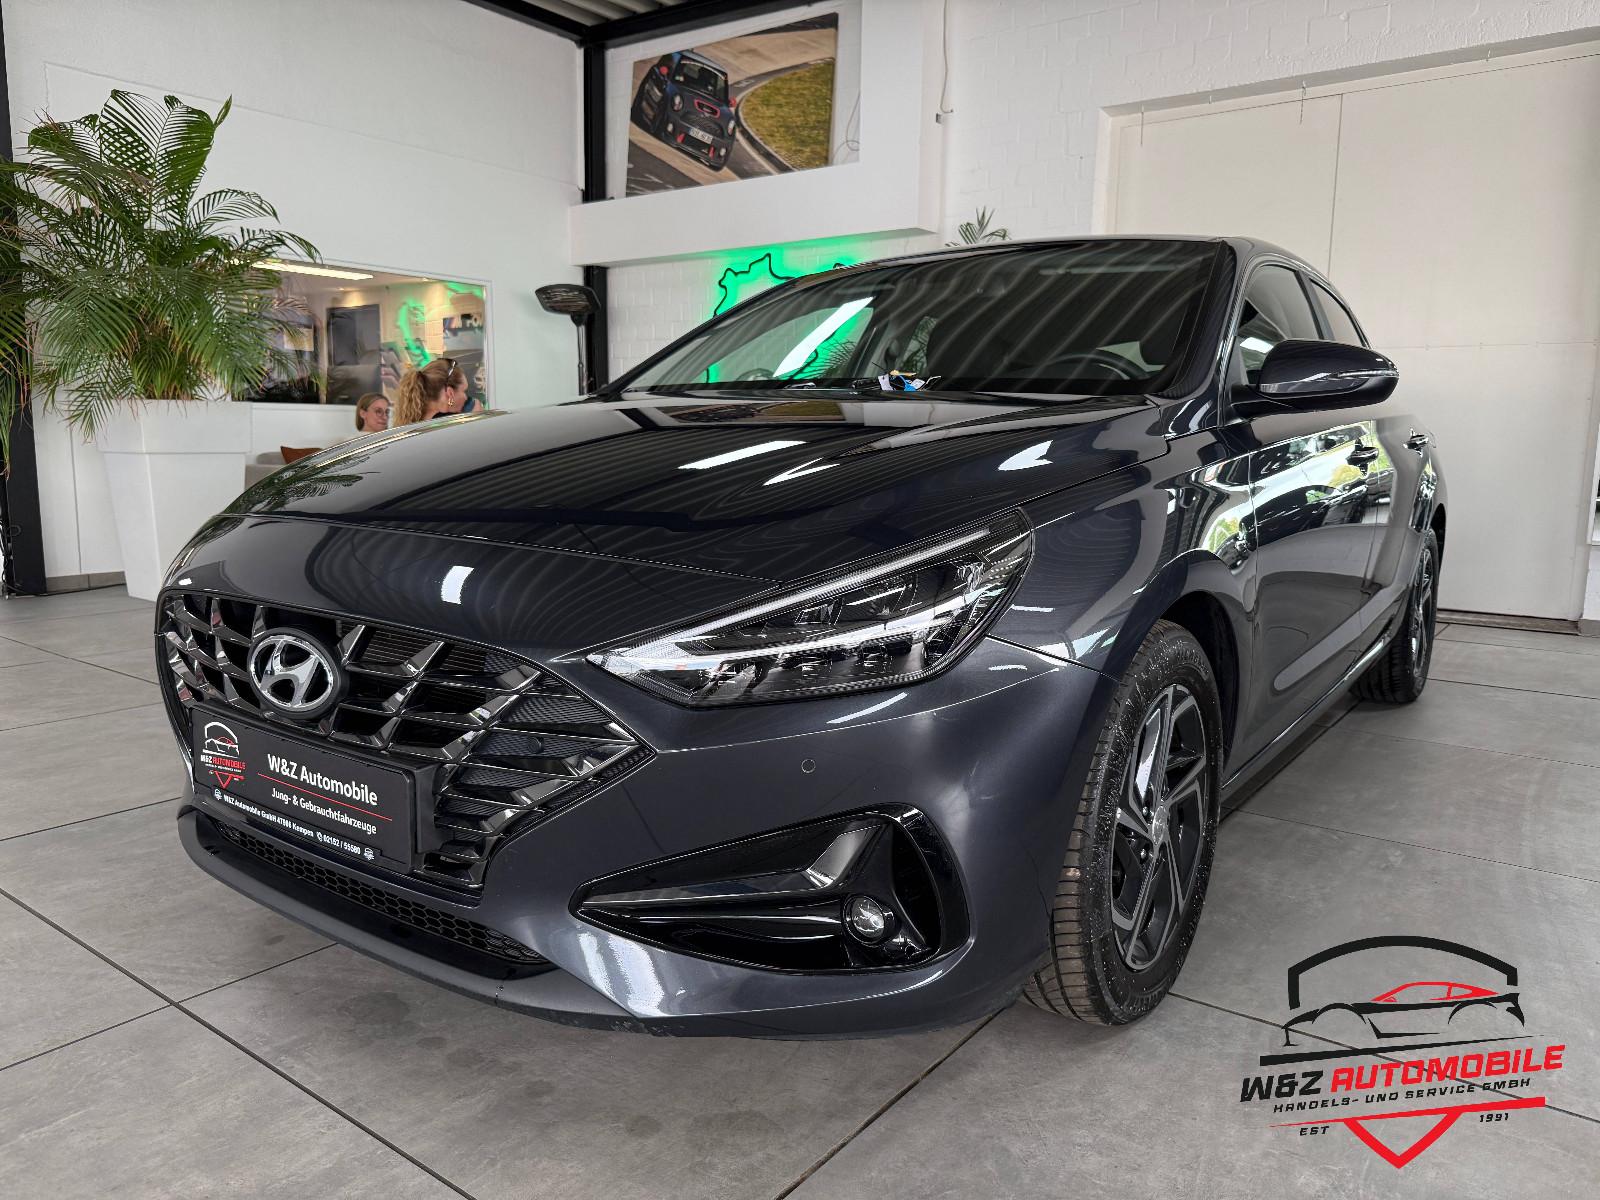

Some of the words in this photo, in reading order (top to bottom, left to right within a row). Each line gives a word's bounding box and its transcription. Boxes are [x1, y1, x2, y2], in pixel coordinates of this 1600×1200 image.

[267, 753, 298, 779] W&Z
[300, 765, 378, 805] Automobile
[223, 794, 235, 806] W&Z
[234, 797, 261, 816] Automobile
[261, 810, 277, 823] GmbH
[292, 821, 314, 837] Kempen
[323, 834, 340, 847] 02152
[272, 788, 292, 804] Jung-
[292, 794, 300, 806] &
[299, 797, 377, 835] Gebrauchtfahrzeuge
